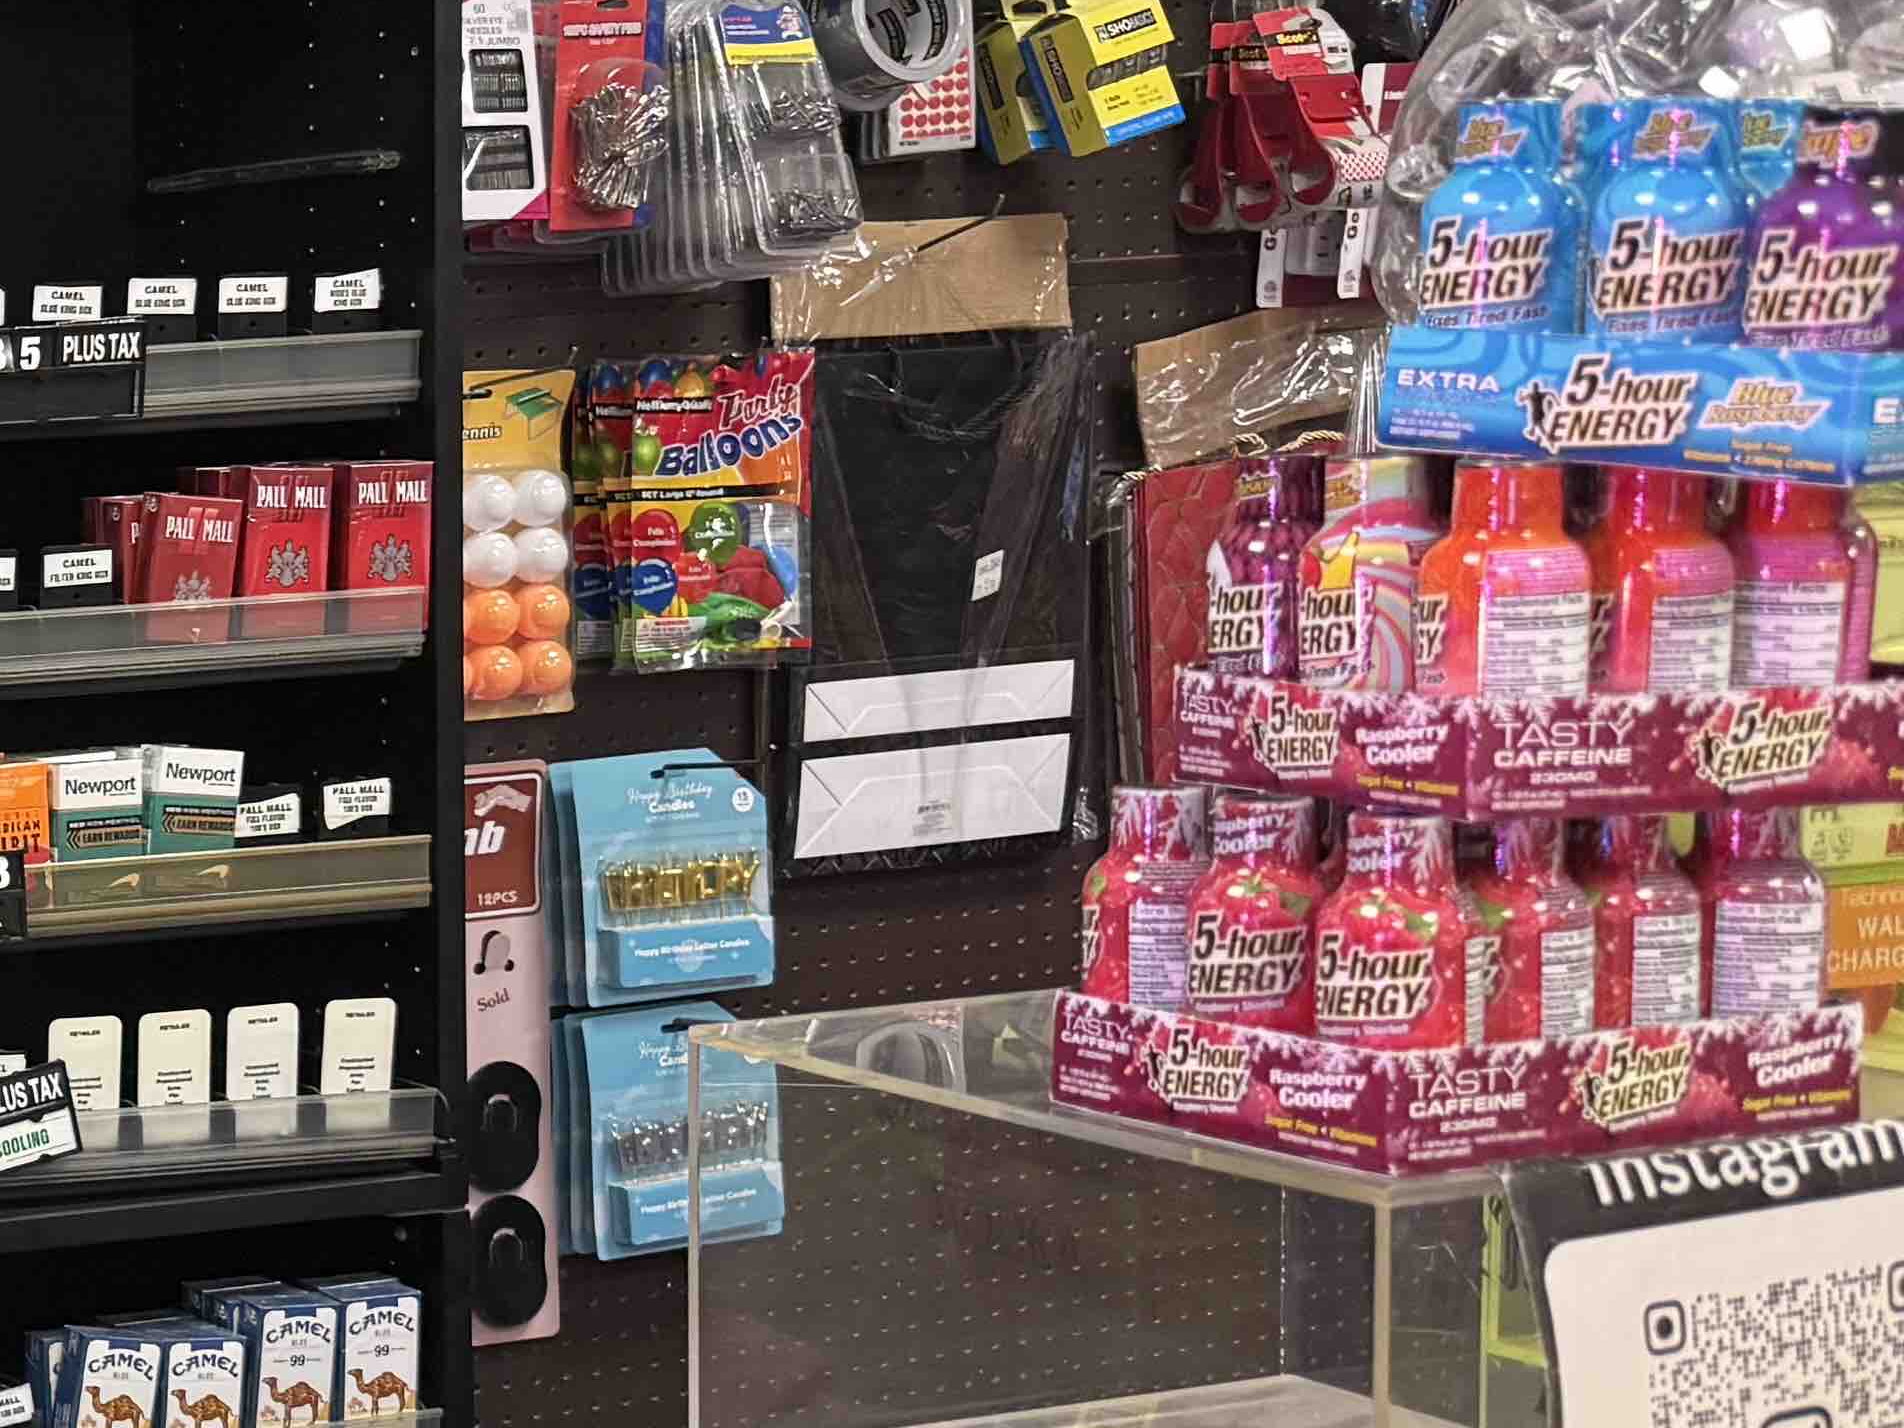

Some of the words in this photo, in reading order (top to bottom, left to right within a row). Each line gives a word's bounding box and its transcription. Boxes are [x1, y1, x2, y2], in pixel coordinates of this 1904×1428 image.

[63, 334, 106, 362] PLUS
[110, 332, 140, 357] TAX
[1398, 369, 1499, 393] EXTRA
[1567, 356, 1692, 408] 5-hour
[1550, 405, 1680, 442] ENERGY
[656, 414, 802, 476] Balloons
[258, 485, 286, 507] PALL
[295, 486, 326, 508] MALL
[358, 481, 387, 503] PALL
[396, 480, 426, 503] MALL
[1495, 721, 1632, 748] TASTY
[1495, 746, 1632, 766] CAFFEINE
[166, 763, 235, 784] Newport
[65, 777, 135, 796] Newport
[649, 800, 694, 813] Candles
[266, 1321, 332, 1344] CAMEL
[88, 1355, 154, 1379] CAMEL
